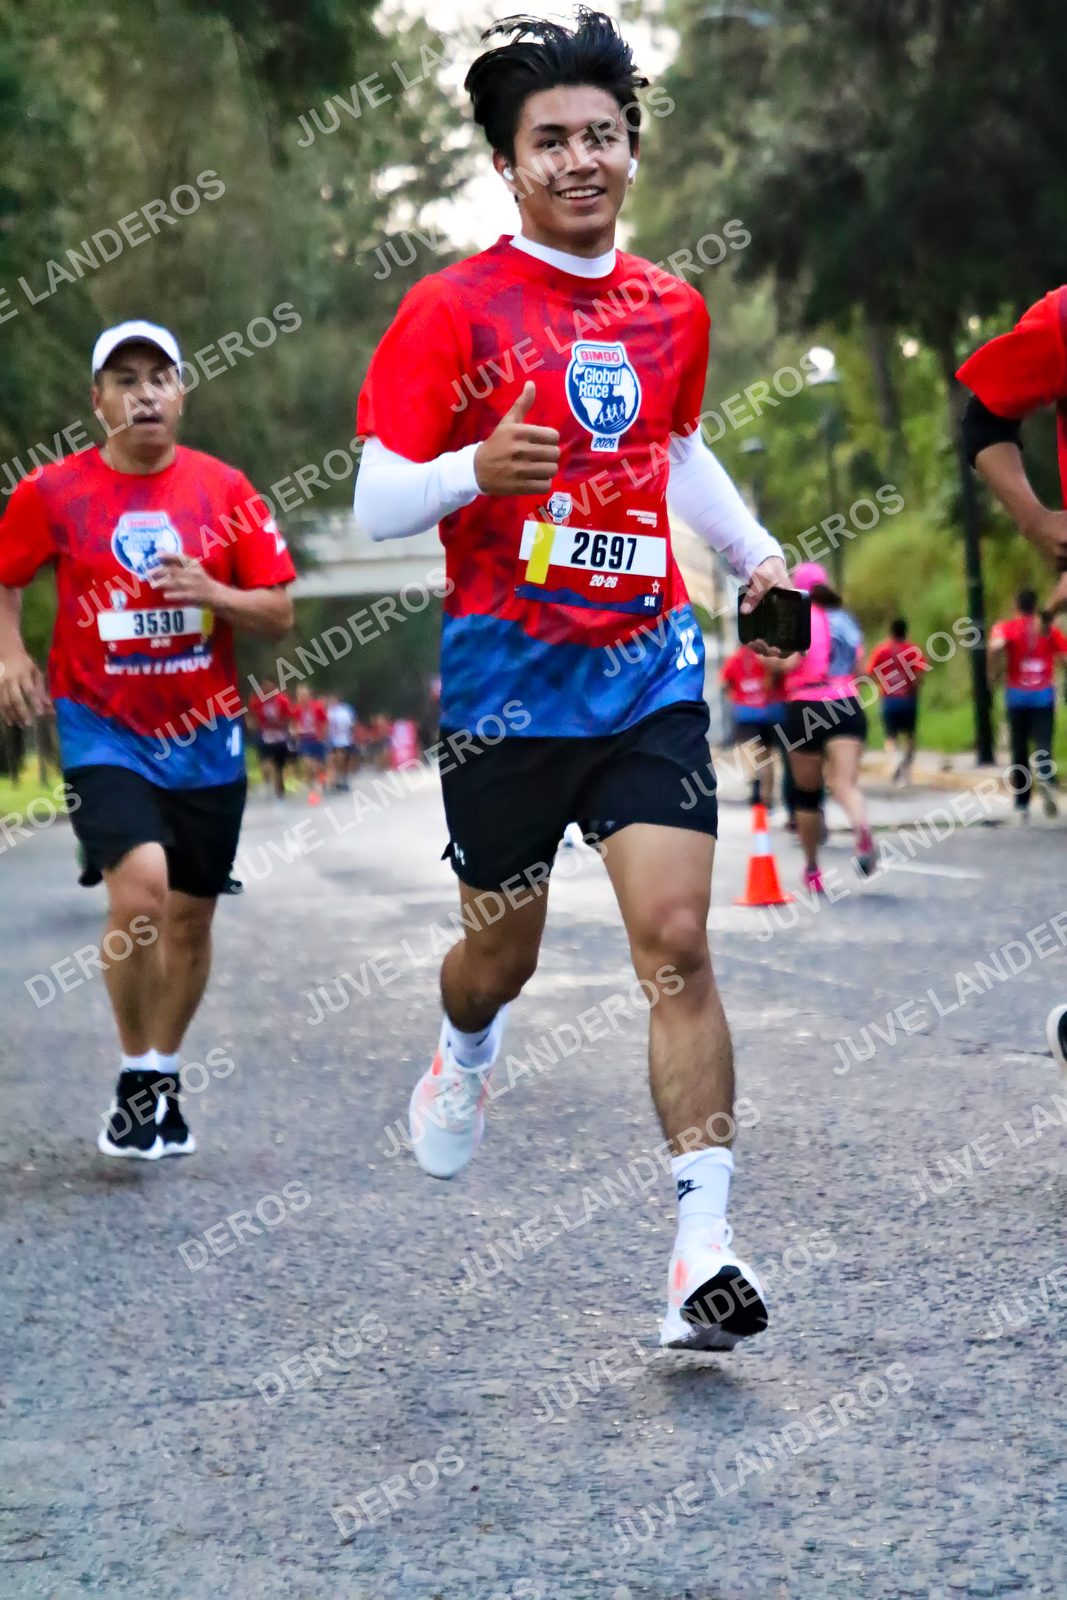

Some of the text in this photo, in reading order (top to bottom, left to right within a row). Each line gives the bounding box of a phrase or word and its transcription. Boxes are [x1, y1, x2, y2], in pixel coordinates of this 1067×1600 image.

[580, 351, 620, 362] BIMBO
[584, 367, 621, 385] Global
[578, 380, 609, 398] Race
[593, 437, 617, 449] 2026
[570, 531, 637, 571] 2697
[589, 574, 619, 588] 20-26
[133, 610, 185, 636] 3530
